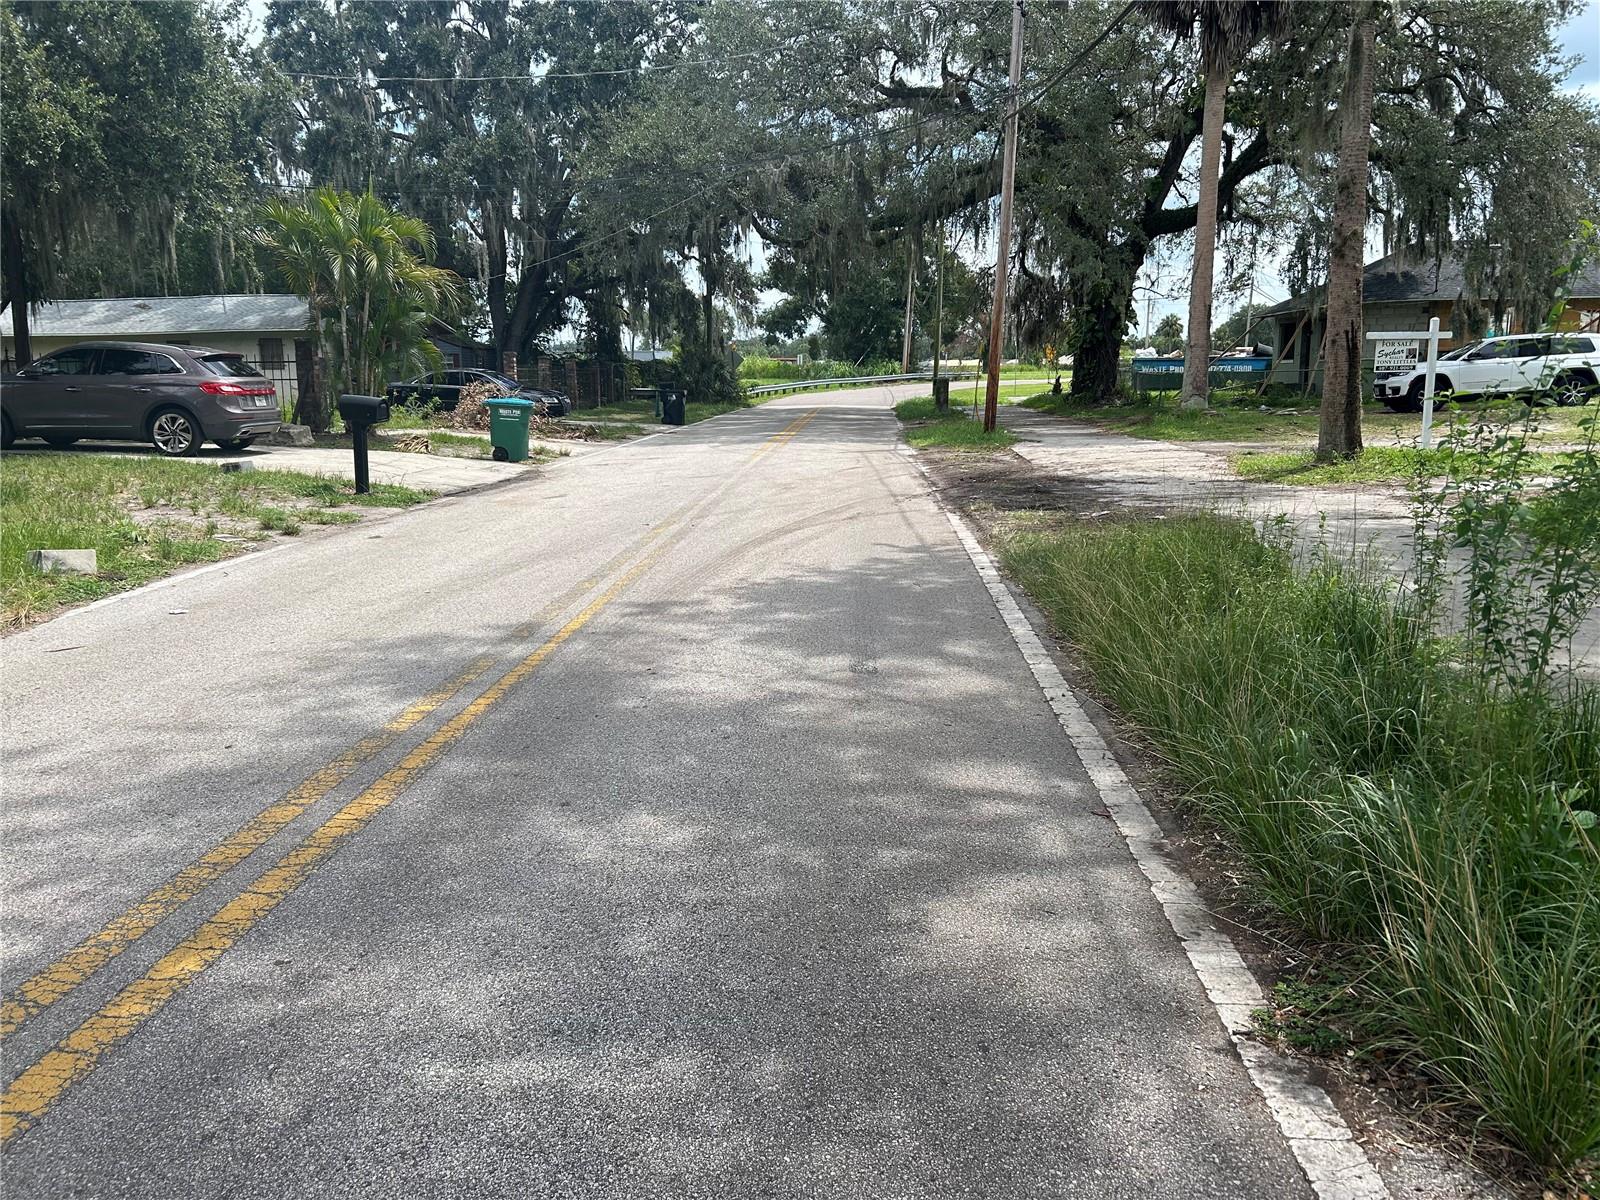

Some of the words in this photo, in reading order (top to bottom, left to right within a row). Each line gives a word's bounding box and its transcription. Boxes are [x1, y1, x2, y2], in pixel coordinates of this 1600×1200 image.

[1382, 339, 1396, 347] FOR
[1397, 339, 1414, 347] SALE
[1141, 365, 1167, 373] WASTE
[1169, 365, 1184, 373] PRO
